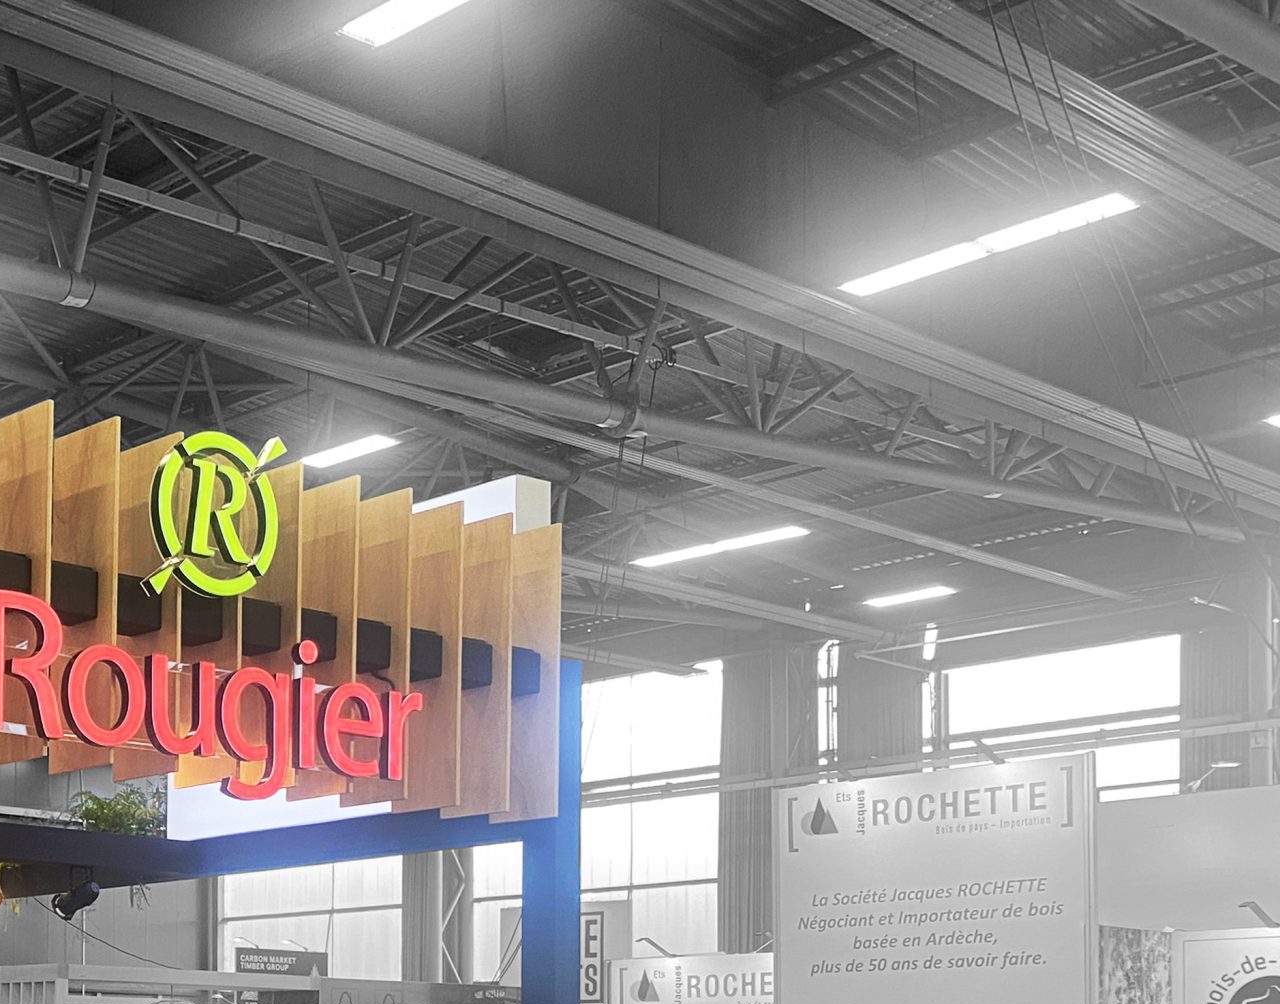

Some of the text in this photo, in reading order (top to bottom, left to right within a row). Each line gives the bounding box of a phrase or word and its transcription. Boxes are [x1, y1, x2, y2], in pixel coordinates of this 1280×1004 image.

[836, 793, 851, 802] Ets
[872, 781, 1047, 827] ROCHETTE
[856, 790, 865, 835] Jacques
[936, 825, 954, 834] Bois
[956, 823, 966, 832] de
[969, 823, 988, 834] pays
[1000, 816, 1051, 828] Importation
[812, 878, 1047, 907] La Société Jacques ROCHETTE
[798, 901, 1064, 933] Négociant et Importateur de bois
[853, 929, 999, 950] basée en Ardèche,
[240, 954, 297, 964] CARBON MARKET
[240, 962, 289, 972] TIMBER GROUP
[810, 951, 1047, 976] plus de 50 ans de savoir faire.
[653, 970, 665, 979] Ets
[674, 965, 682, 1004] Jacques
[687, 972, 773, 998] ROCHE
